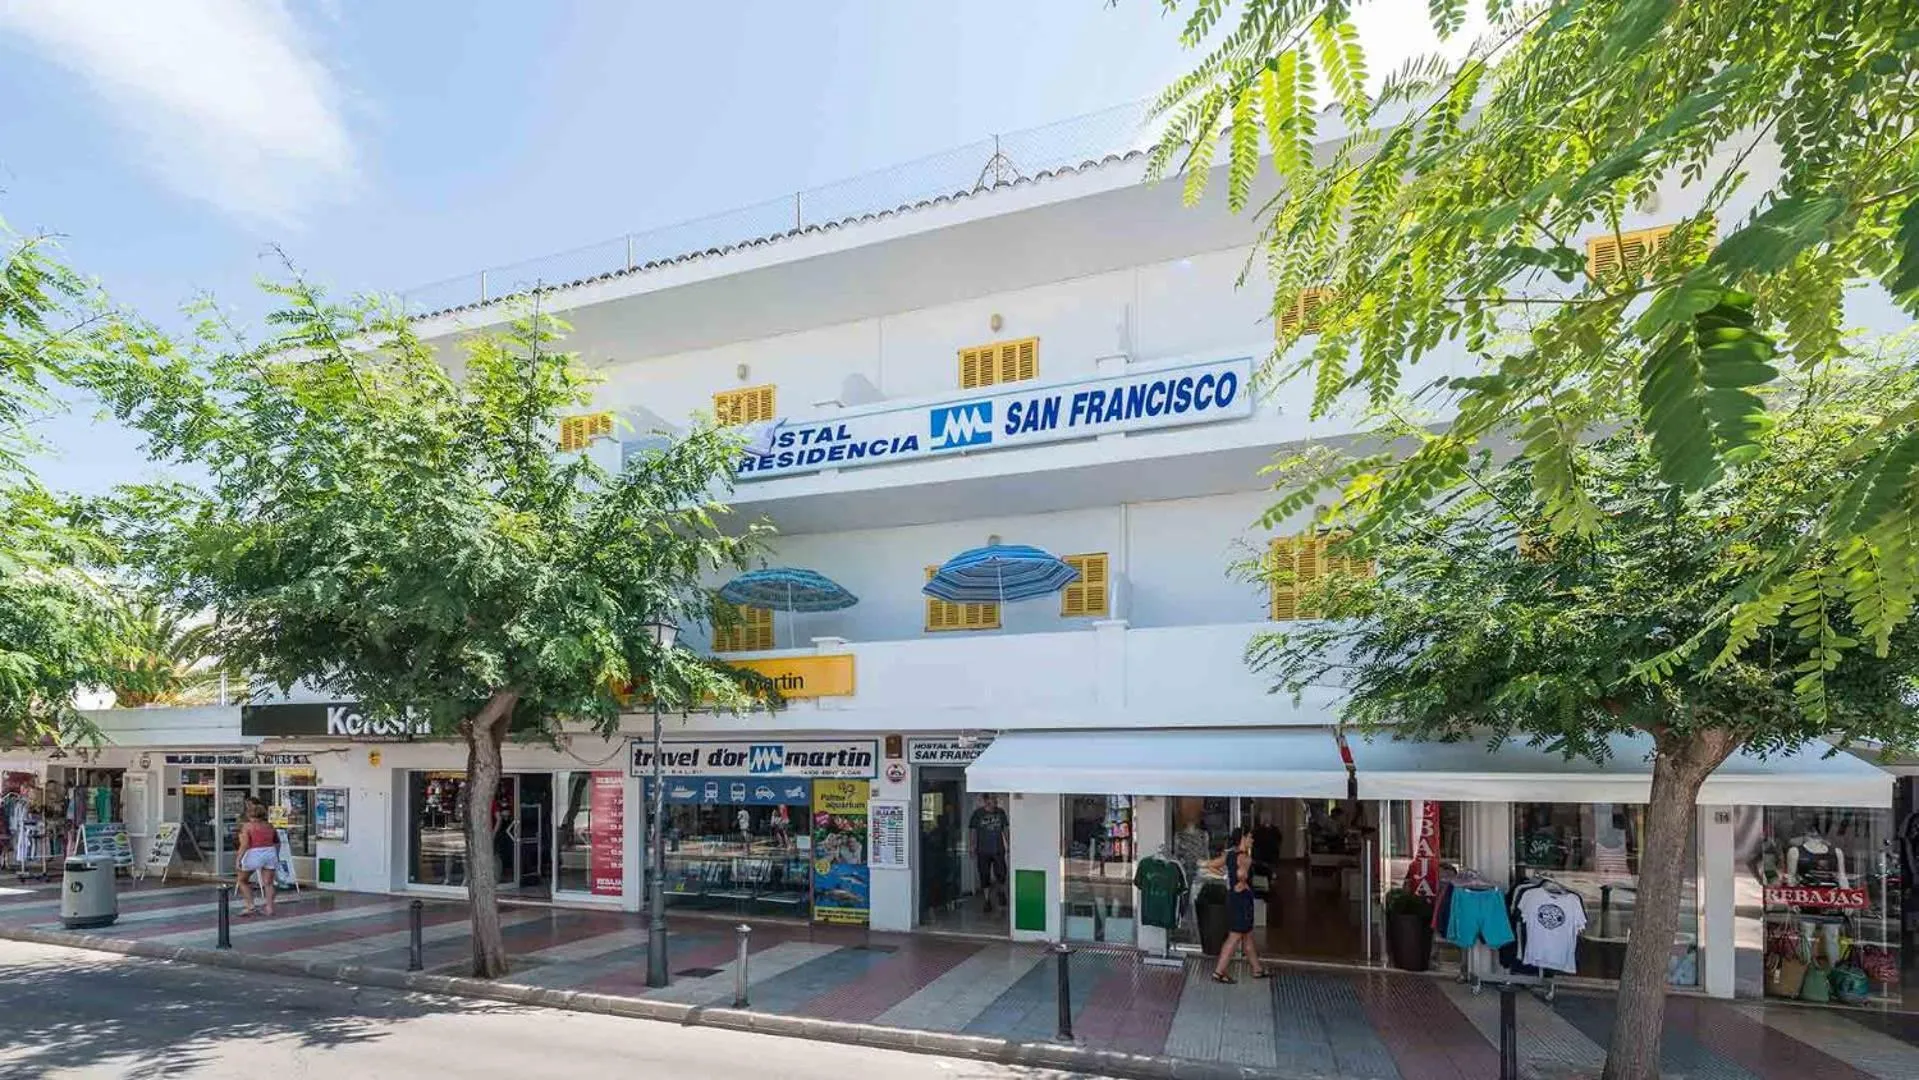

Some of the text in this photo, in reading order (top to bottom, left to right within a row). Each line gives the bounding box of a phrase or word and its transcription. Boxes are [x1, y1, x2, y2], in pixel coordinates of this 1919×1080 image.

[1004, 371, 1238, 436] SAN FRANCISCO
[772, 424, 852, 449] STAL
[737, 435, 919, 472] RESIDENCIA
[707, 747, 748, 767] d'or
[785, 747, 872, 767] martin
[914, 750, 937, 760] SAN
[1765, 888, 1865, 906] REBAJAS
